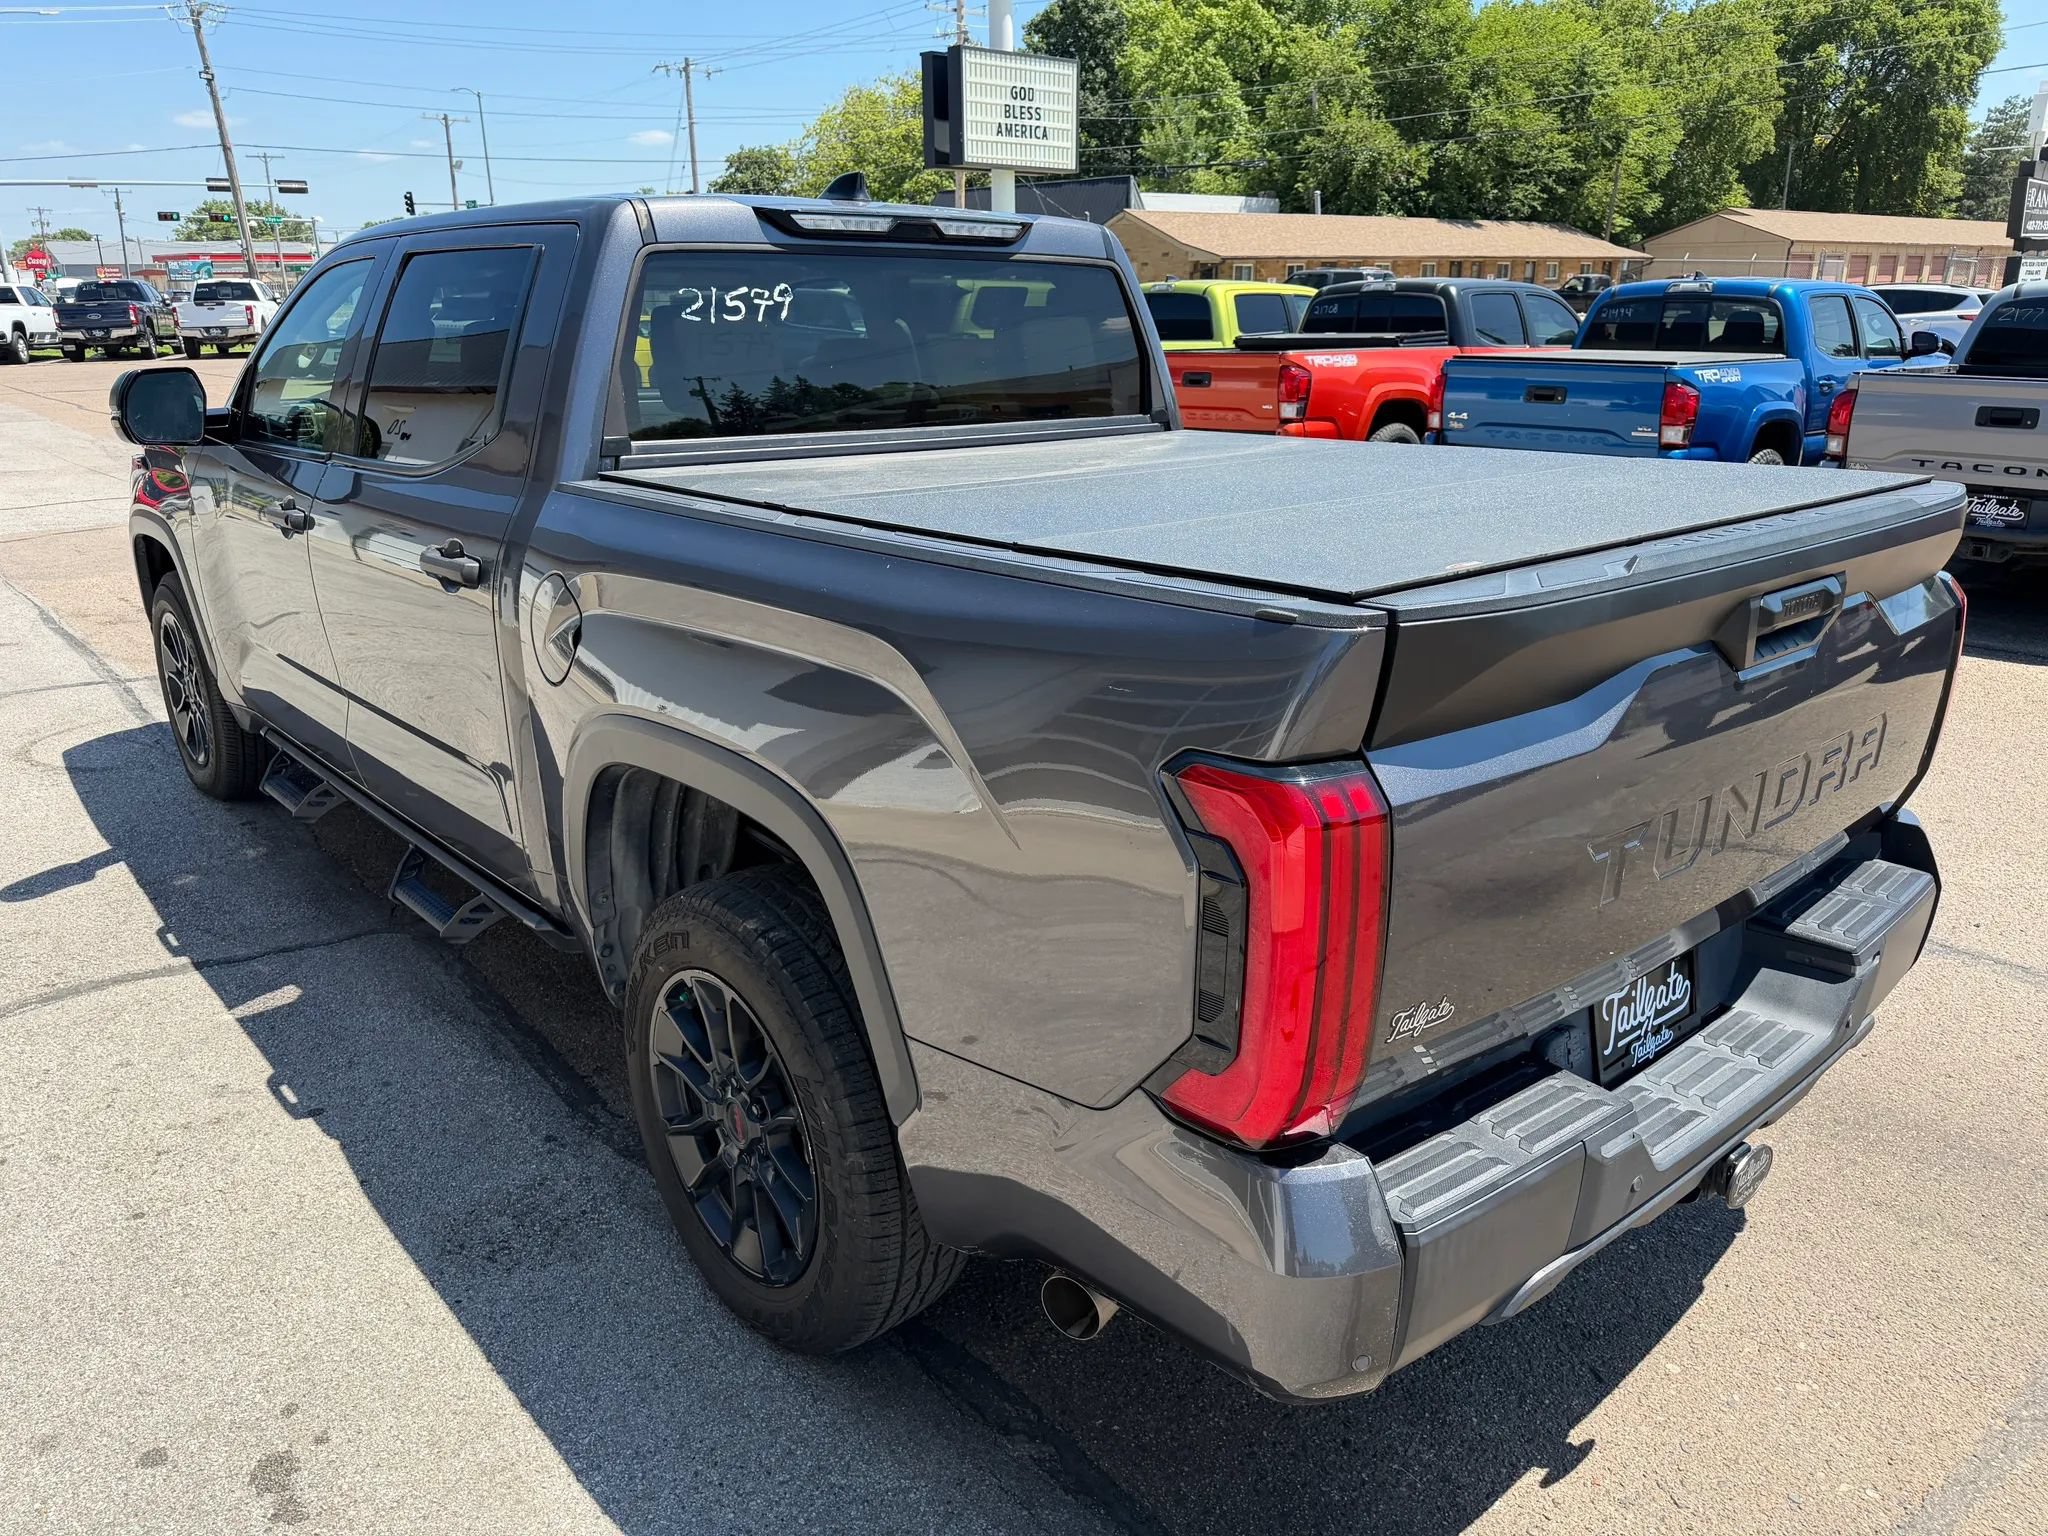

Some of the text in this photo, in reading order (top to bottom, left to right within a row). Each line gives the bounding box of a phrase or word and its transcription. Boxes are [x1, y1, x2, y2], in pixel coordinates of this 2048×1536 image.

[1010, 85, 1035, 102] GOD
[1004, 103, 1042, 121] BLESS
[996, 122, 1049, 141] AMERICA
[27, 257, 51, 267] Casey
[678, 282, 794, 325] 21579
[1313, 303, 1339, 315] 21708
[1694, 368, 1720, 384] TRD
[1484, 428, 1611, 447] TACOMA
[1966, 498, 2025, 521] Tailgate
[1587, 712, 1888, 907] TUNDRA
[1602, 961, 1691, 1055] Tailgate
[1386, 995, 1455, 1042] Tailgate
[1630, 1026, 1674, 1067] Tailgate
